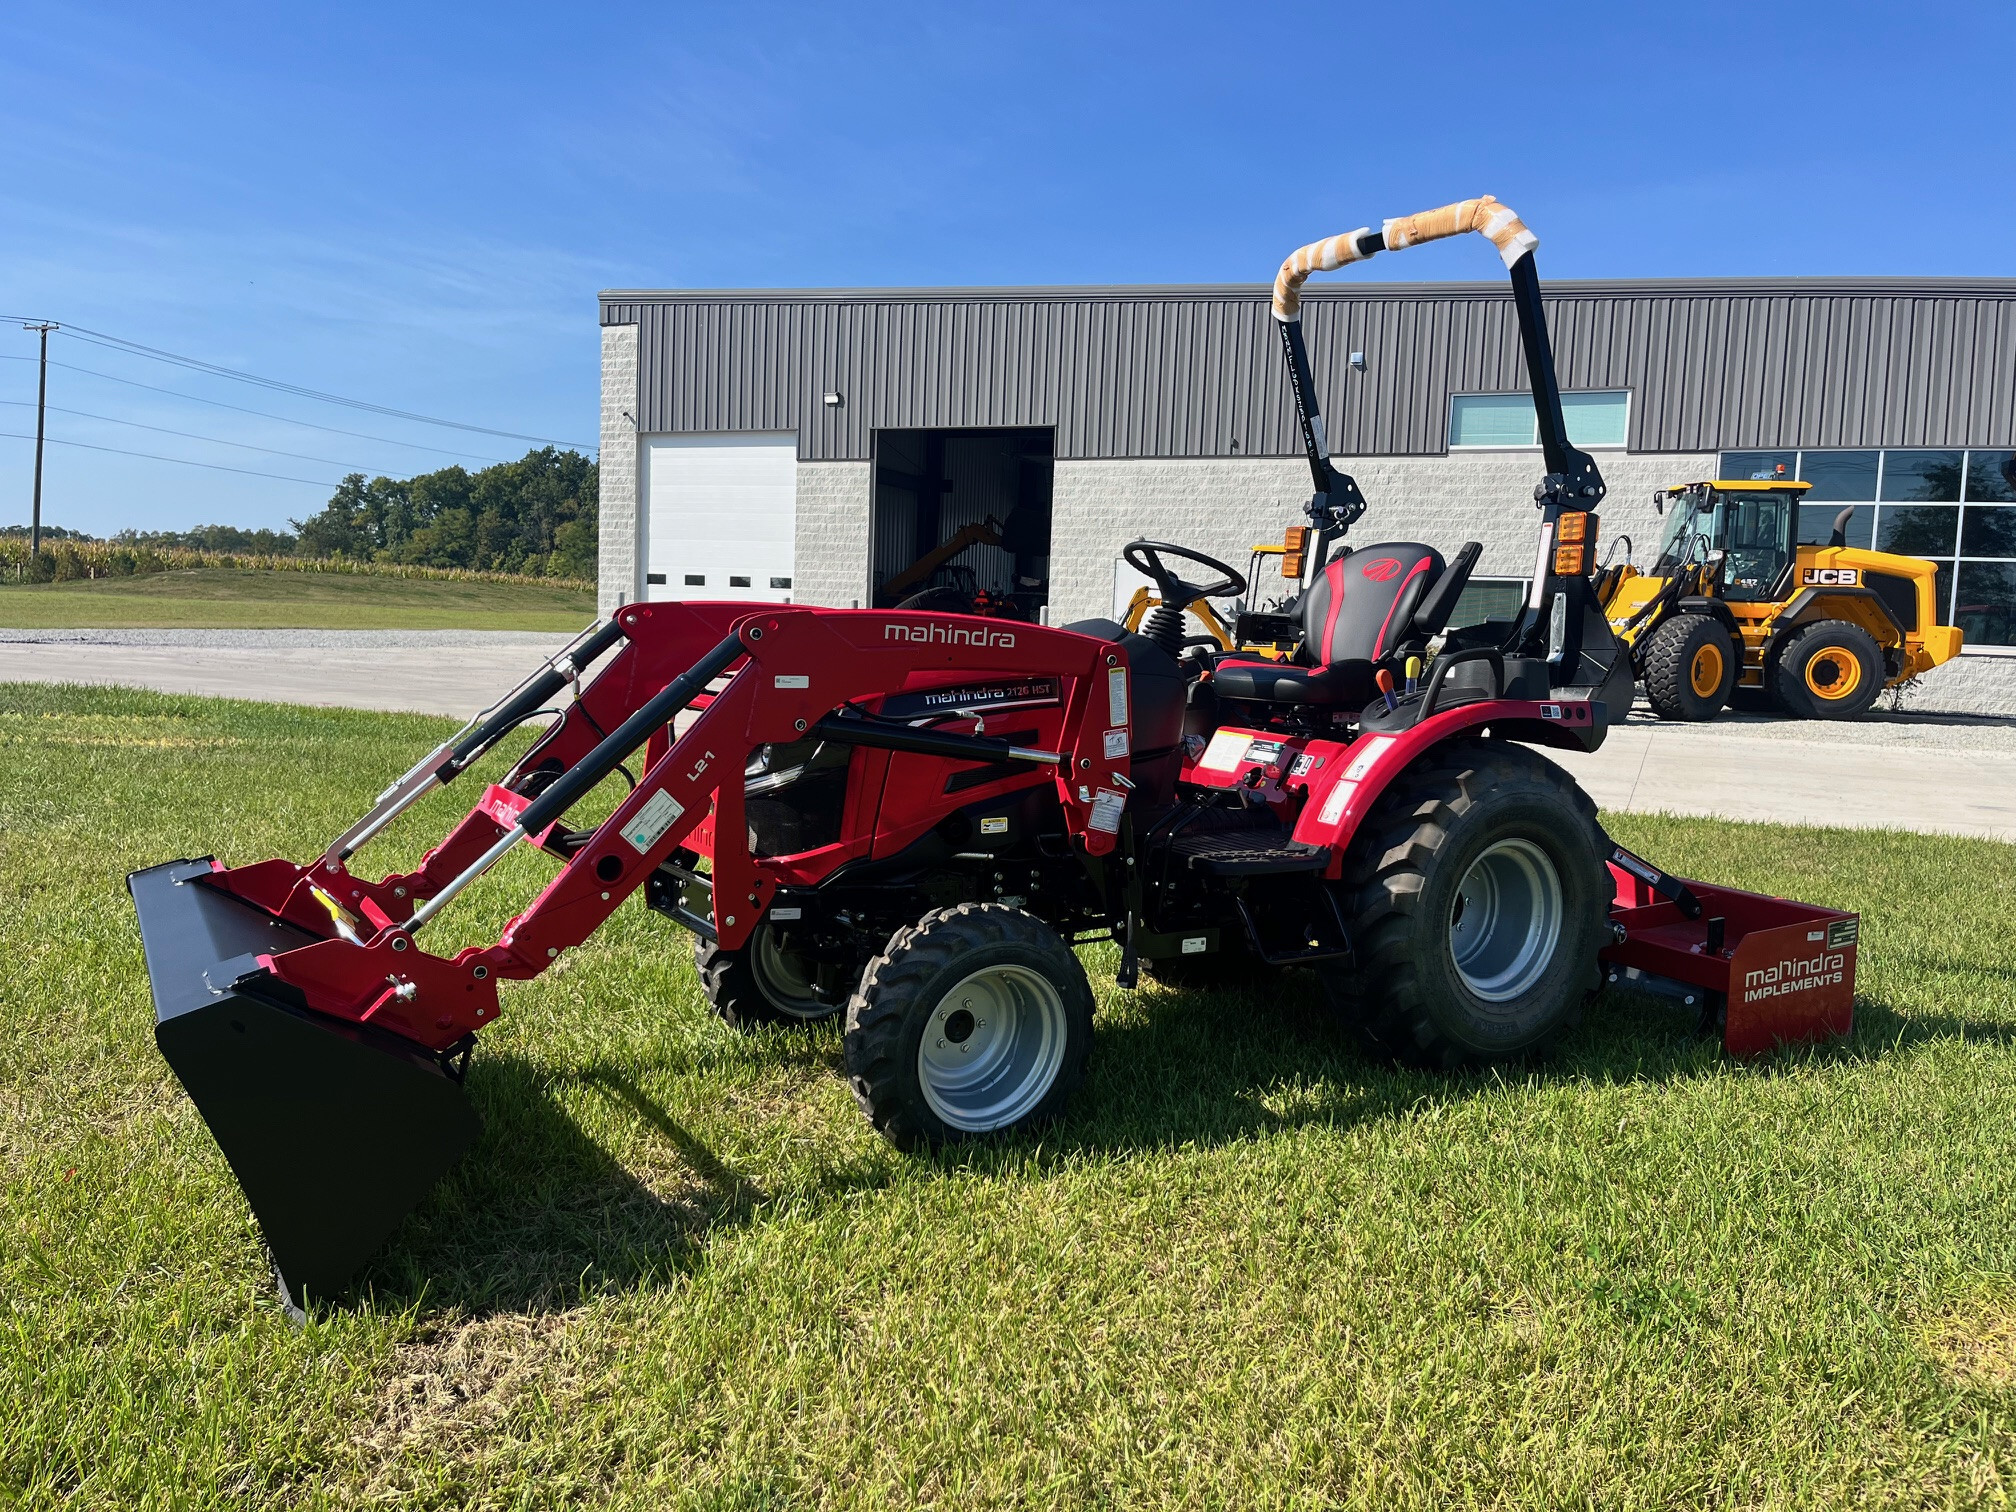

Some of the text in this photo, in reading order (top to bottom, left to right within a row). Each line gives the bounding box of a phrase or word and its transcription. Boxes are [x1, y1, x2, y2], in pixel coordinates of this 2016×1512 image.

[1804, 569, 1857, 584] JCB
[884, 622, 1015, 648] mahindra
[925, 684, 1050, 705] mahindra 2126 HST
[686, 751, 715, 782] L21
[490, 800, 520, 827] mahin
[1745, 952, 1844, 988] mahindra
[1744, 971, 1843, 1003] IMPLEMENTS
